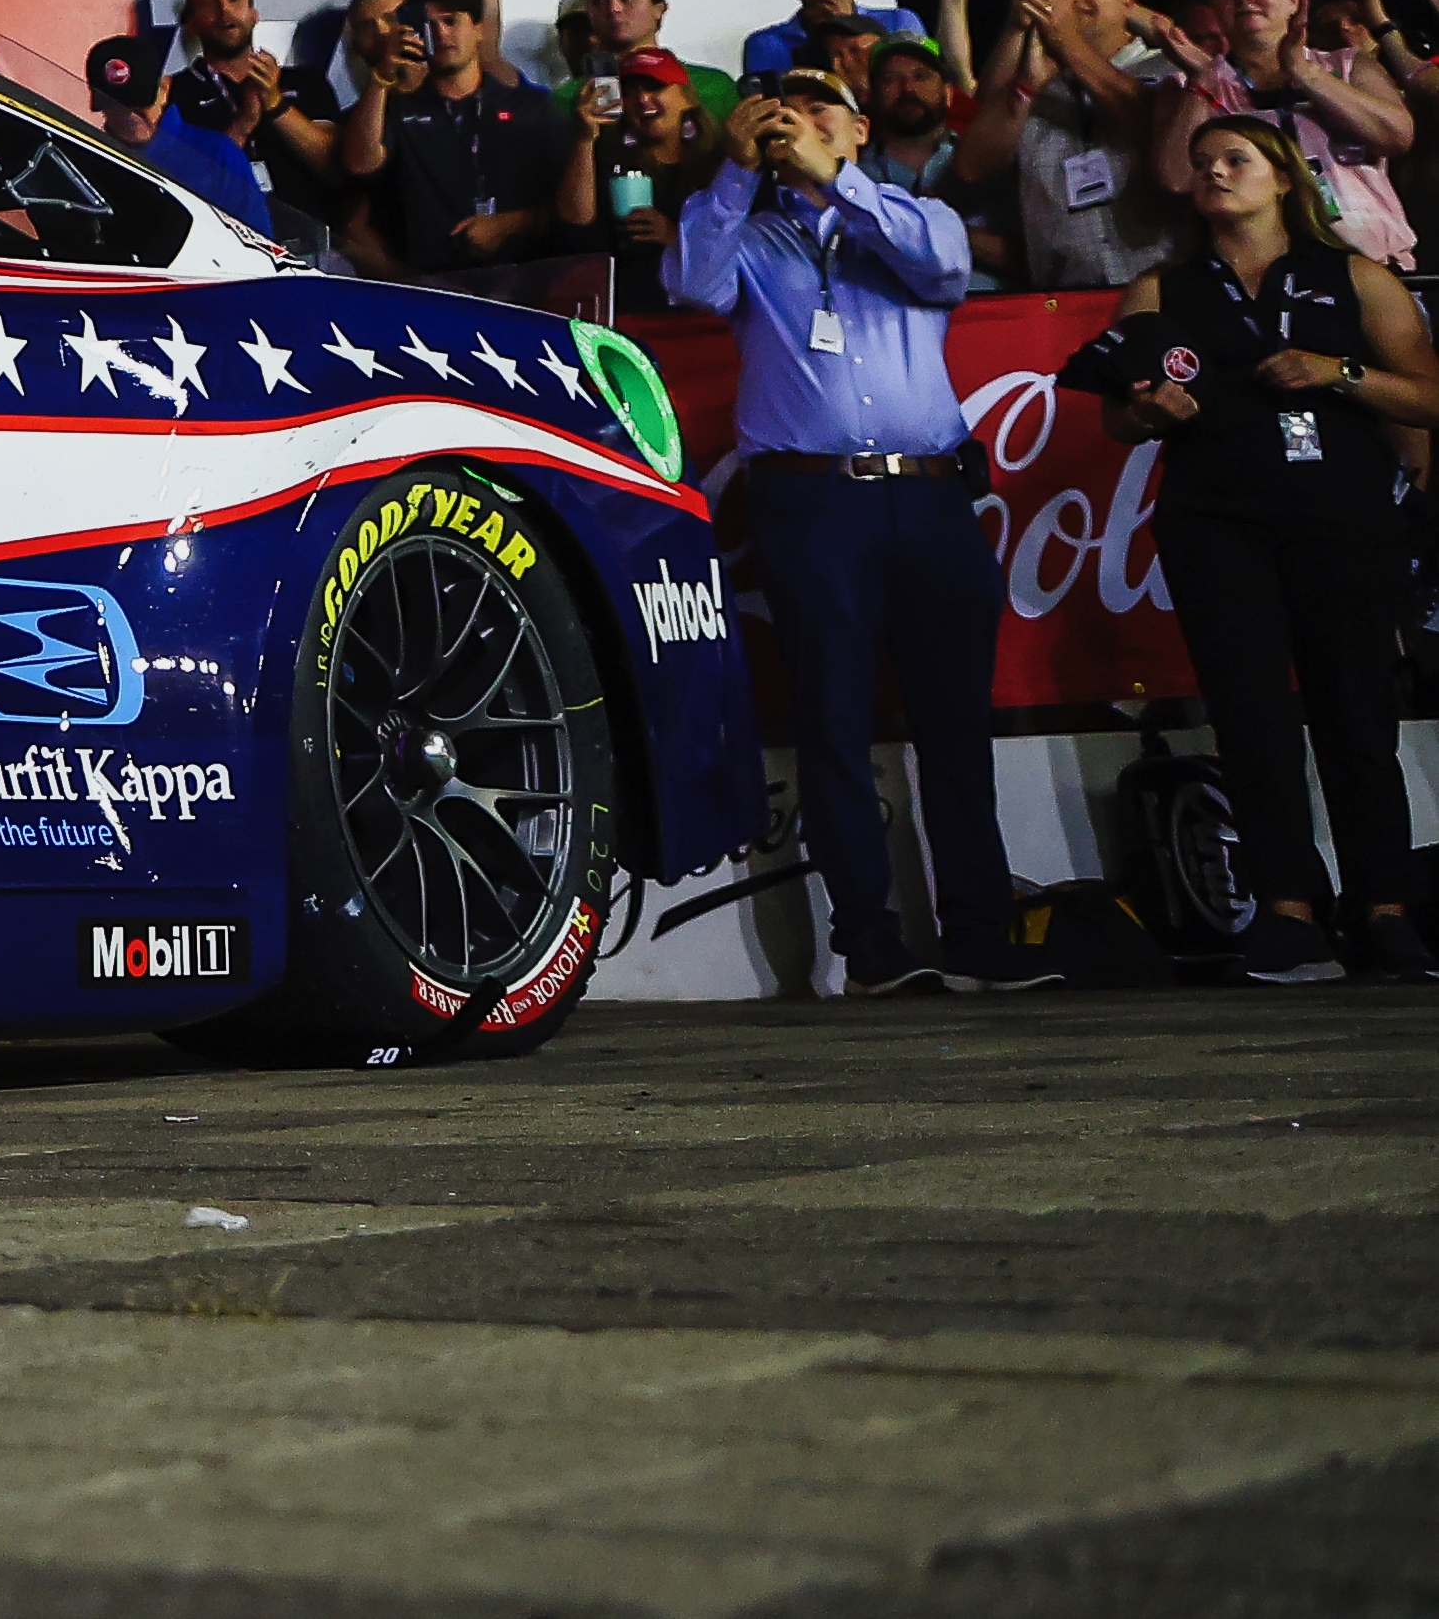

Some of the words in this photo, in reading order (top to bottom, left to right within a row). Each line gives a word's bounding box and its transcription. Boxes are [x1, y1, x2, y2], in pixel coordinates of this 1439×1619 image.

[324, 484, 536, 628] GOODYEAR
[632, 558, 727, 663] yahoo!
[82, 747, 234, 821] Kappa
[38, 817, 113, 848] future
[92, 925, 190, 978] Mobil
[528, 934, 585, 1005] HONOR
[512, 997, 532, 1014] AND
[367, 1047, 400, 1064] 20
